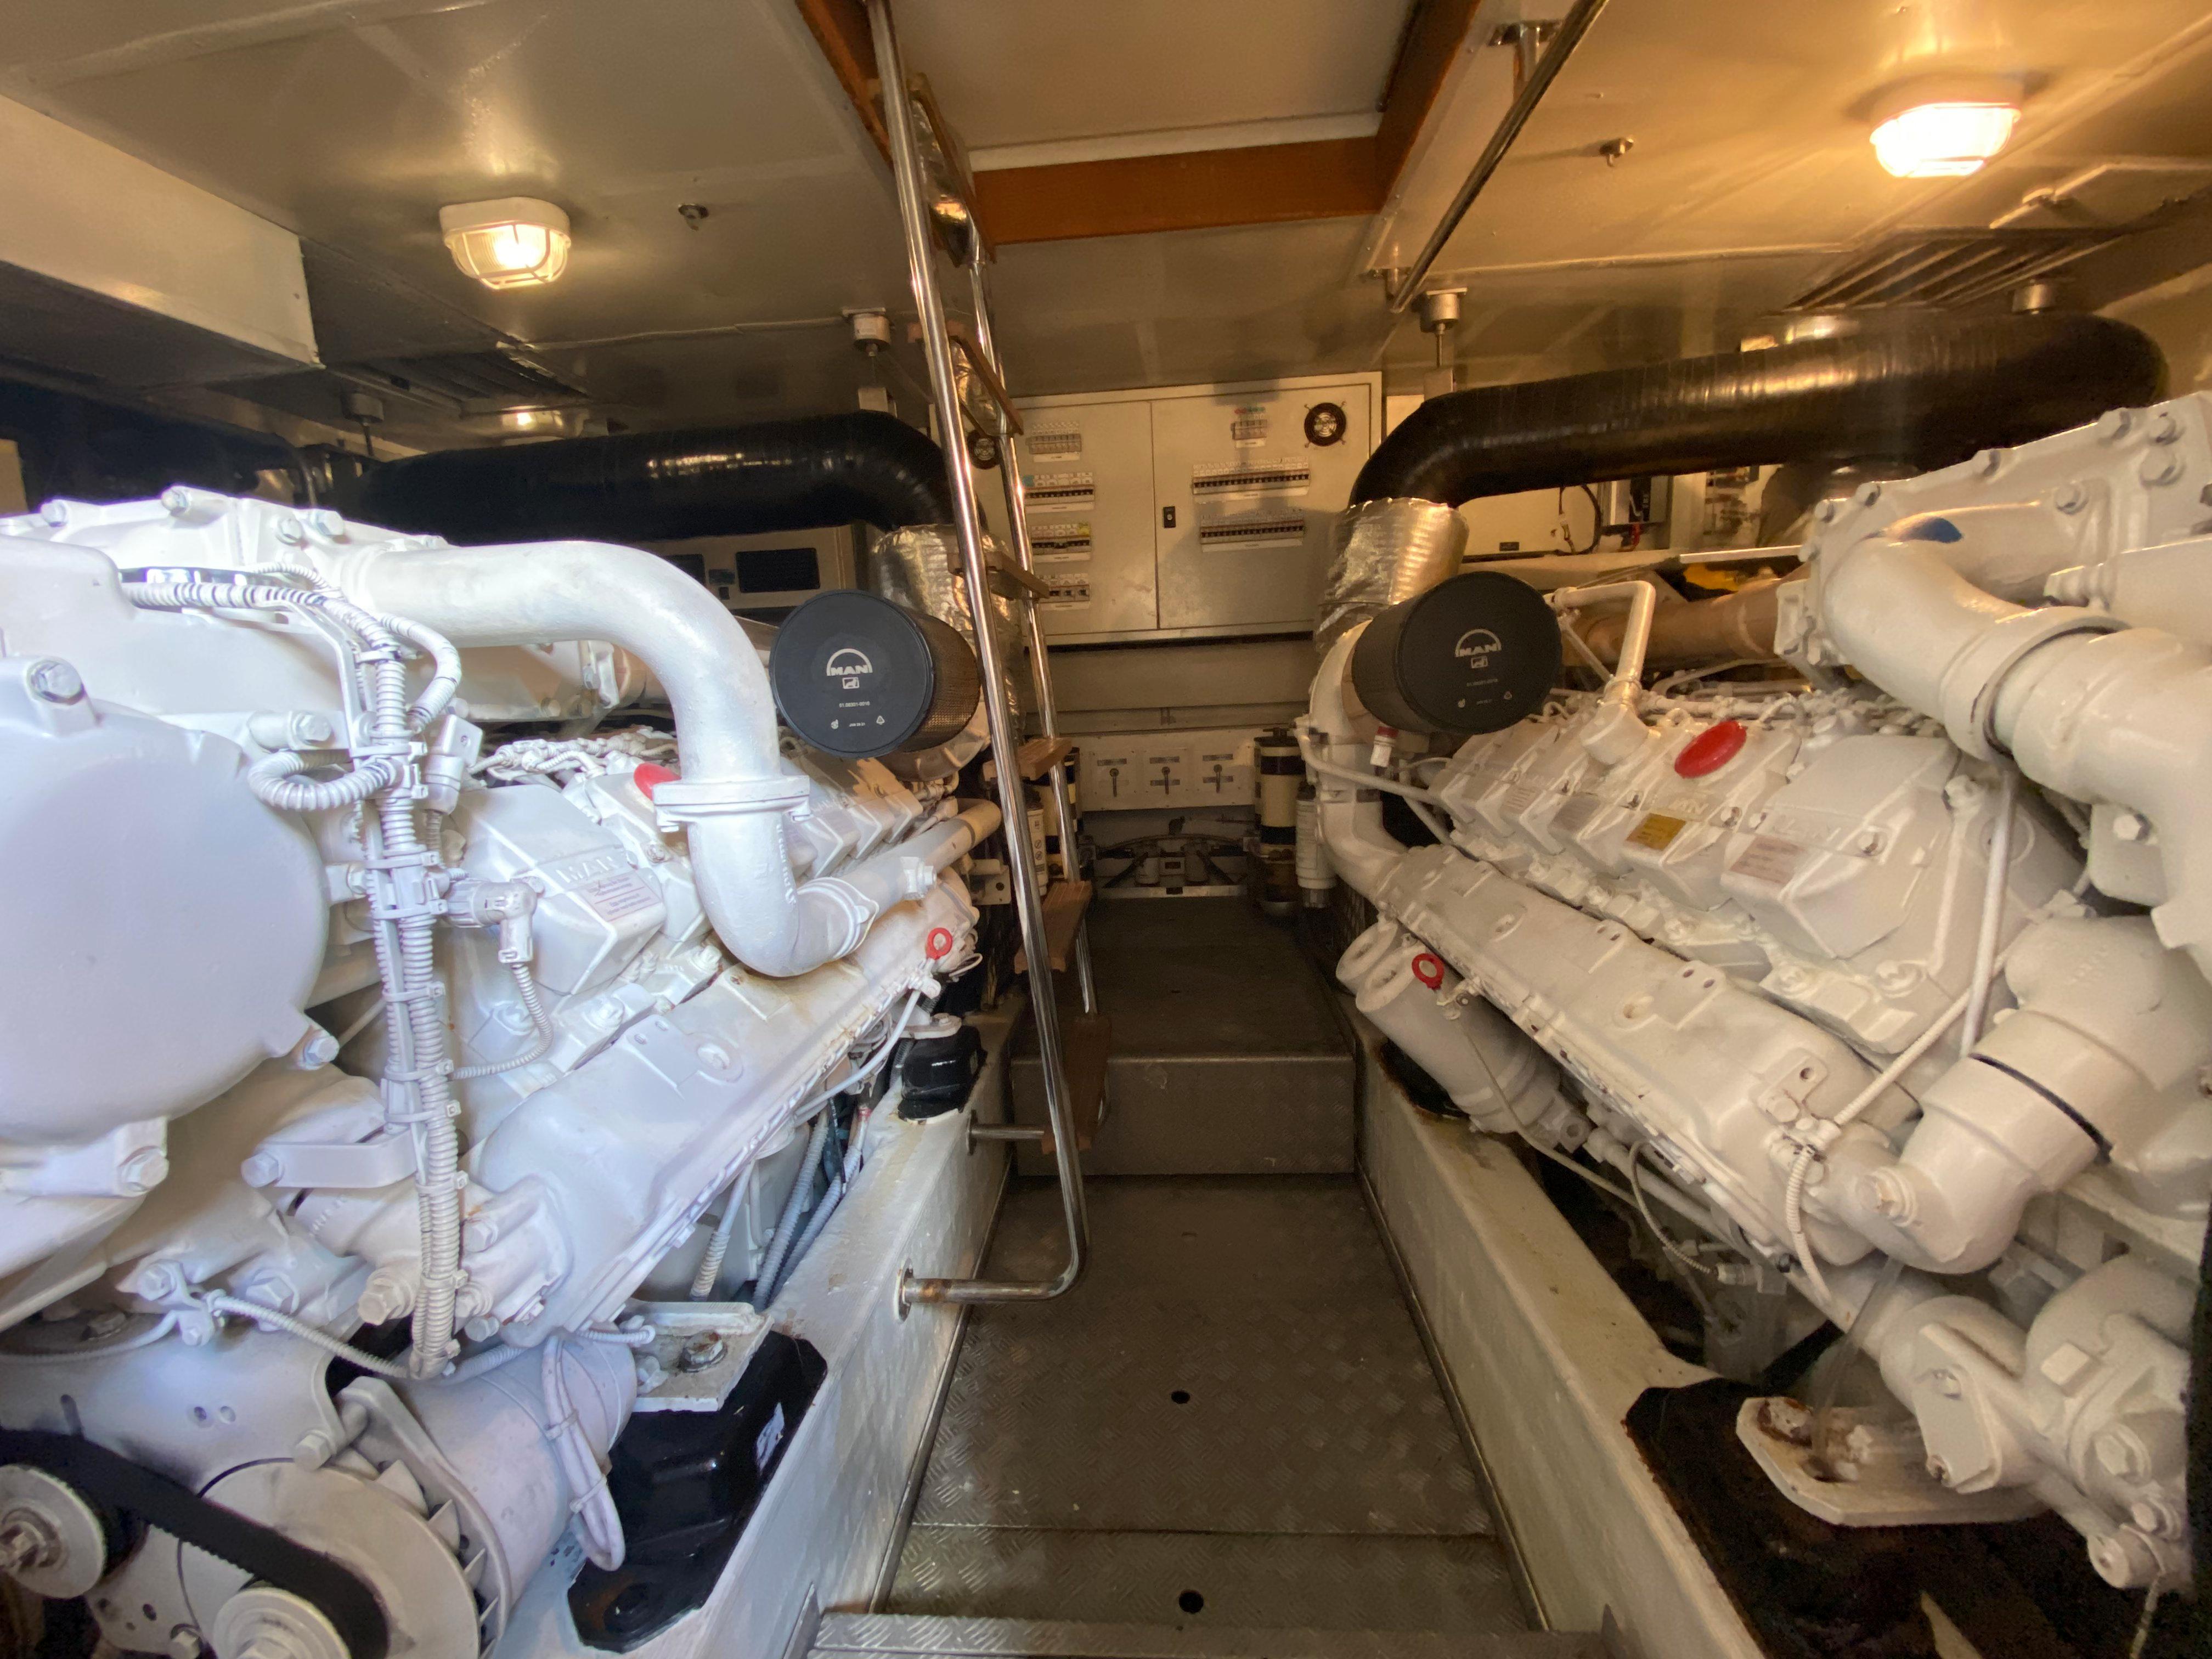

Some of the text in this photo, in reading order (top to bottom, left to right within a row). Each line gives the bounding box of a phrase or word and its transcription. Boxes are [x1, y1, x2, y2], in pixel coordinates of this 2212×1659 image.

[1459, 643, 1497, 656] MAN
[830, 664, 869, 676] MAN
[556, 855, 619, 883] MAN
